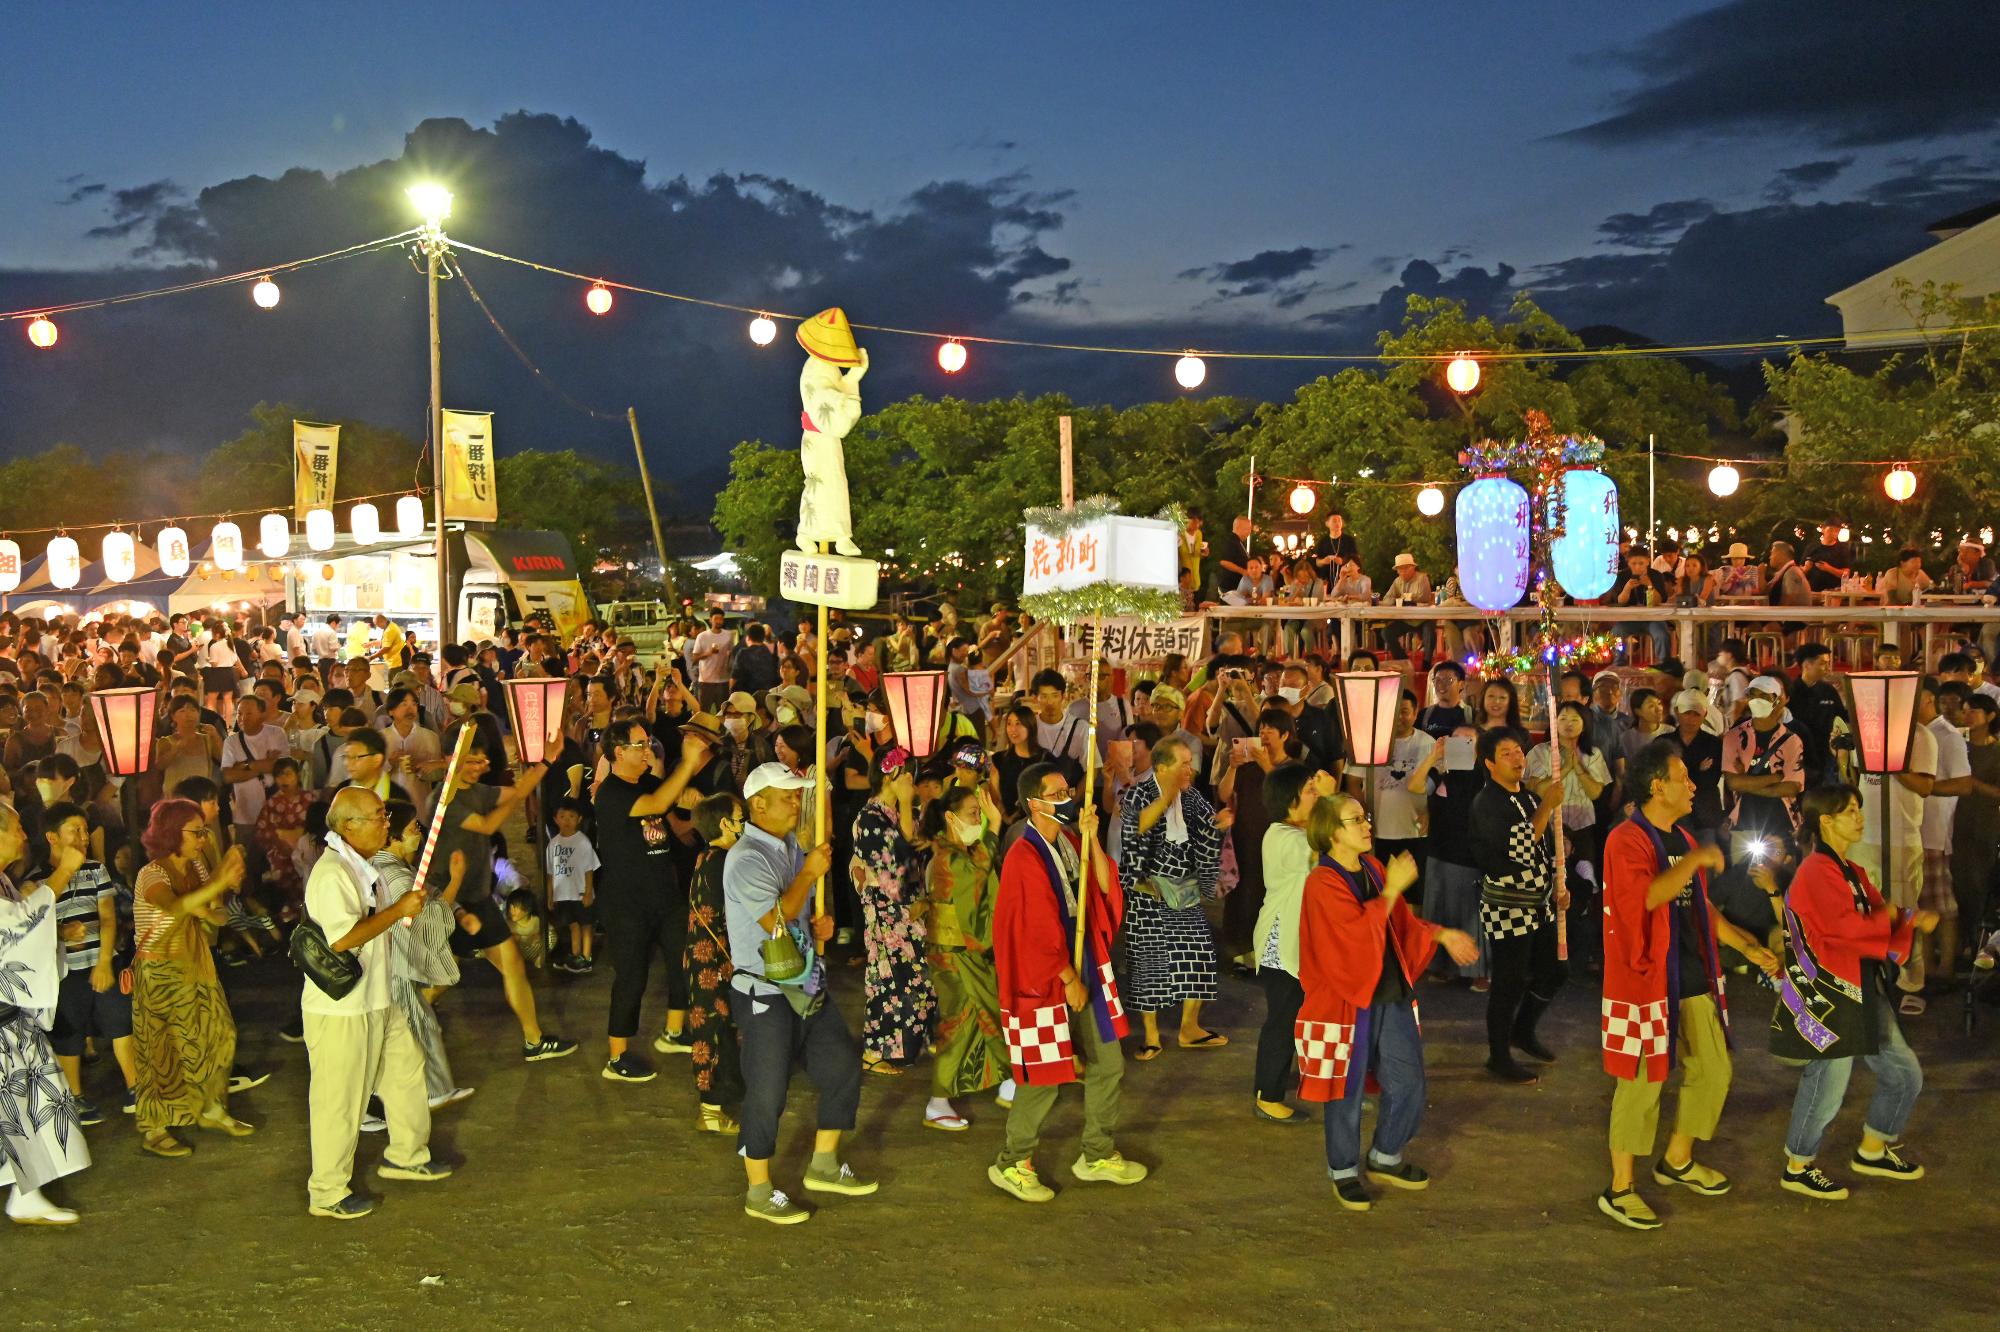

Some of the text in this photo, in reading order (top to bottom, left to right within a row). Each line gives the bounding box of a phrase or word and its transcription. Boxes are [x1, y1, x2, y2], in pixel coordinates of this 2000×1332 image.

[512, 555, 565, 571] KIRIN
[1078, 622, 1201, 662] 有料休憩所
[524, 691, 541, 746] 丹波篠山
[555, 845, 576, 858] Day
[556, 865, 575, 877] Day
